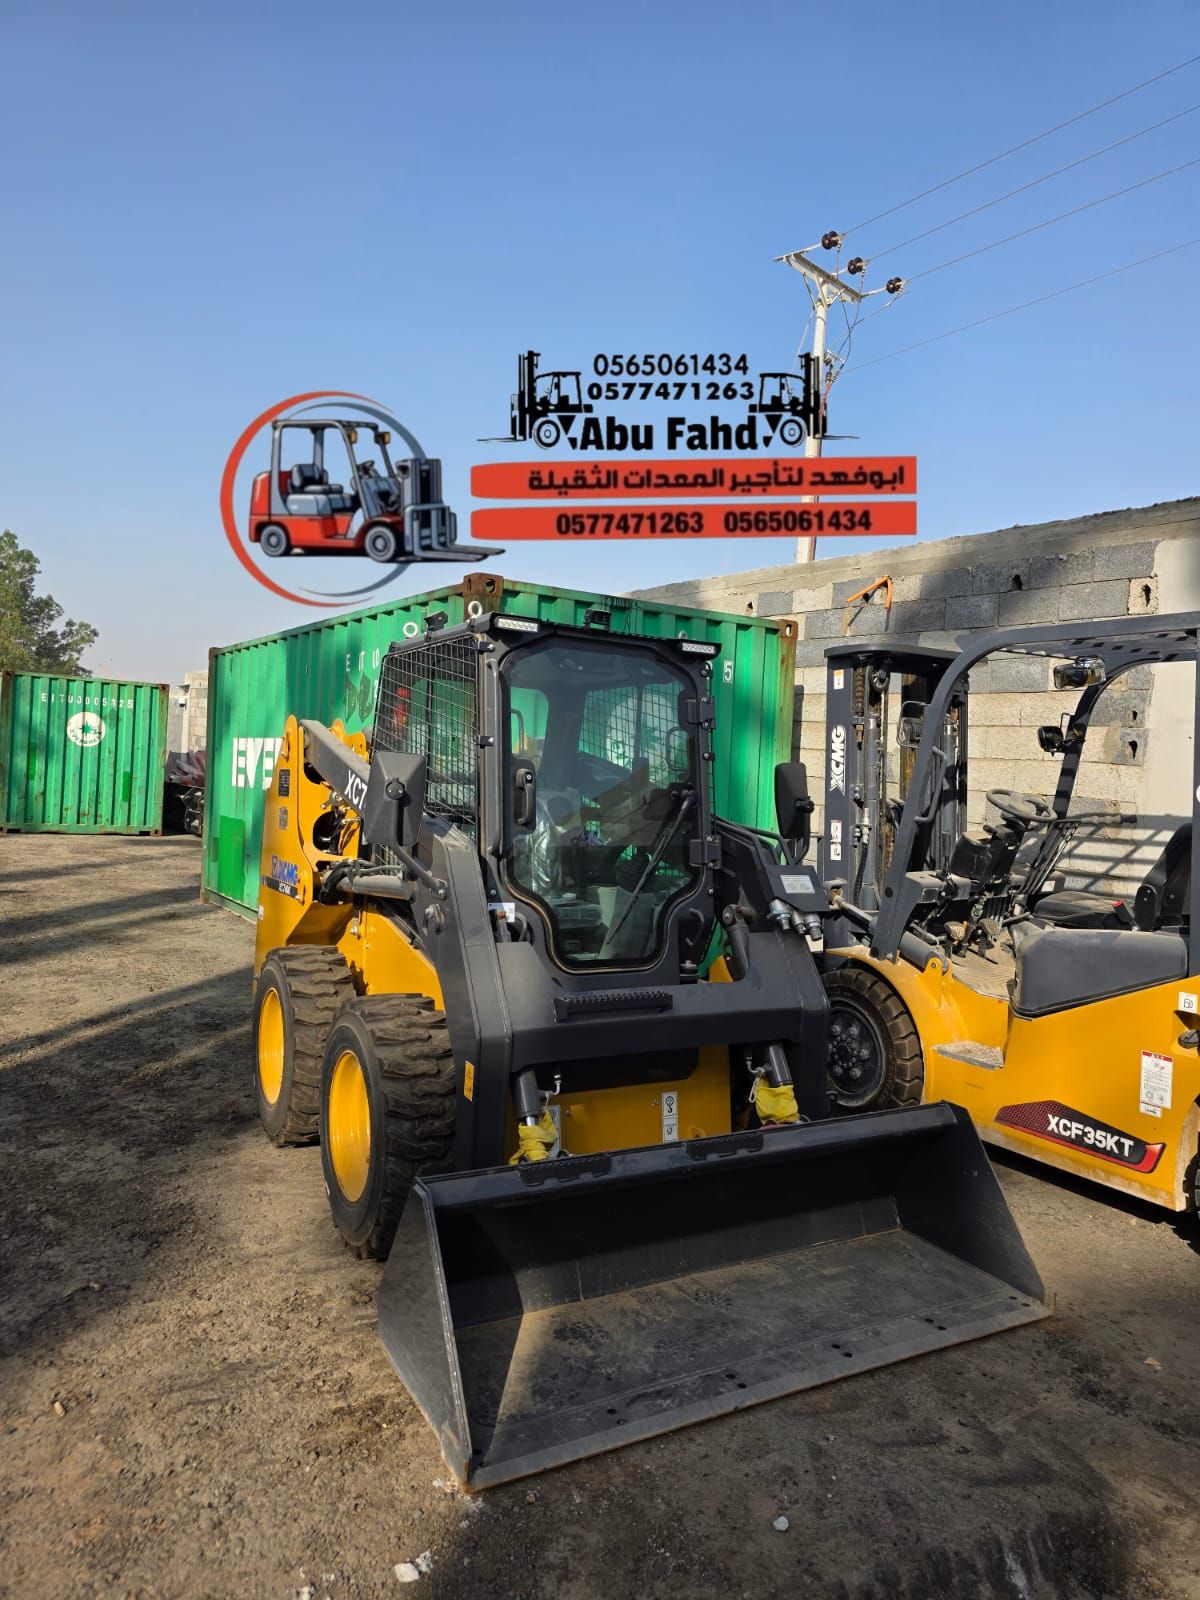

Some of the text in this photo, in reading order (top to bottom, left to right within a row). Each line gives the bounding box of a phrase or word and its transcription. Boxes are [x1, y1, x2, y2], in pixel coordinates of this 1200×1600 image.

[829, 724, 846, 797] XCMG
[344, 769, 368, 810] XC7
[1047, 1113, 1134, 1157] XCF35KT
